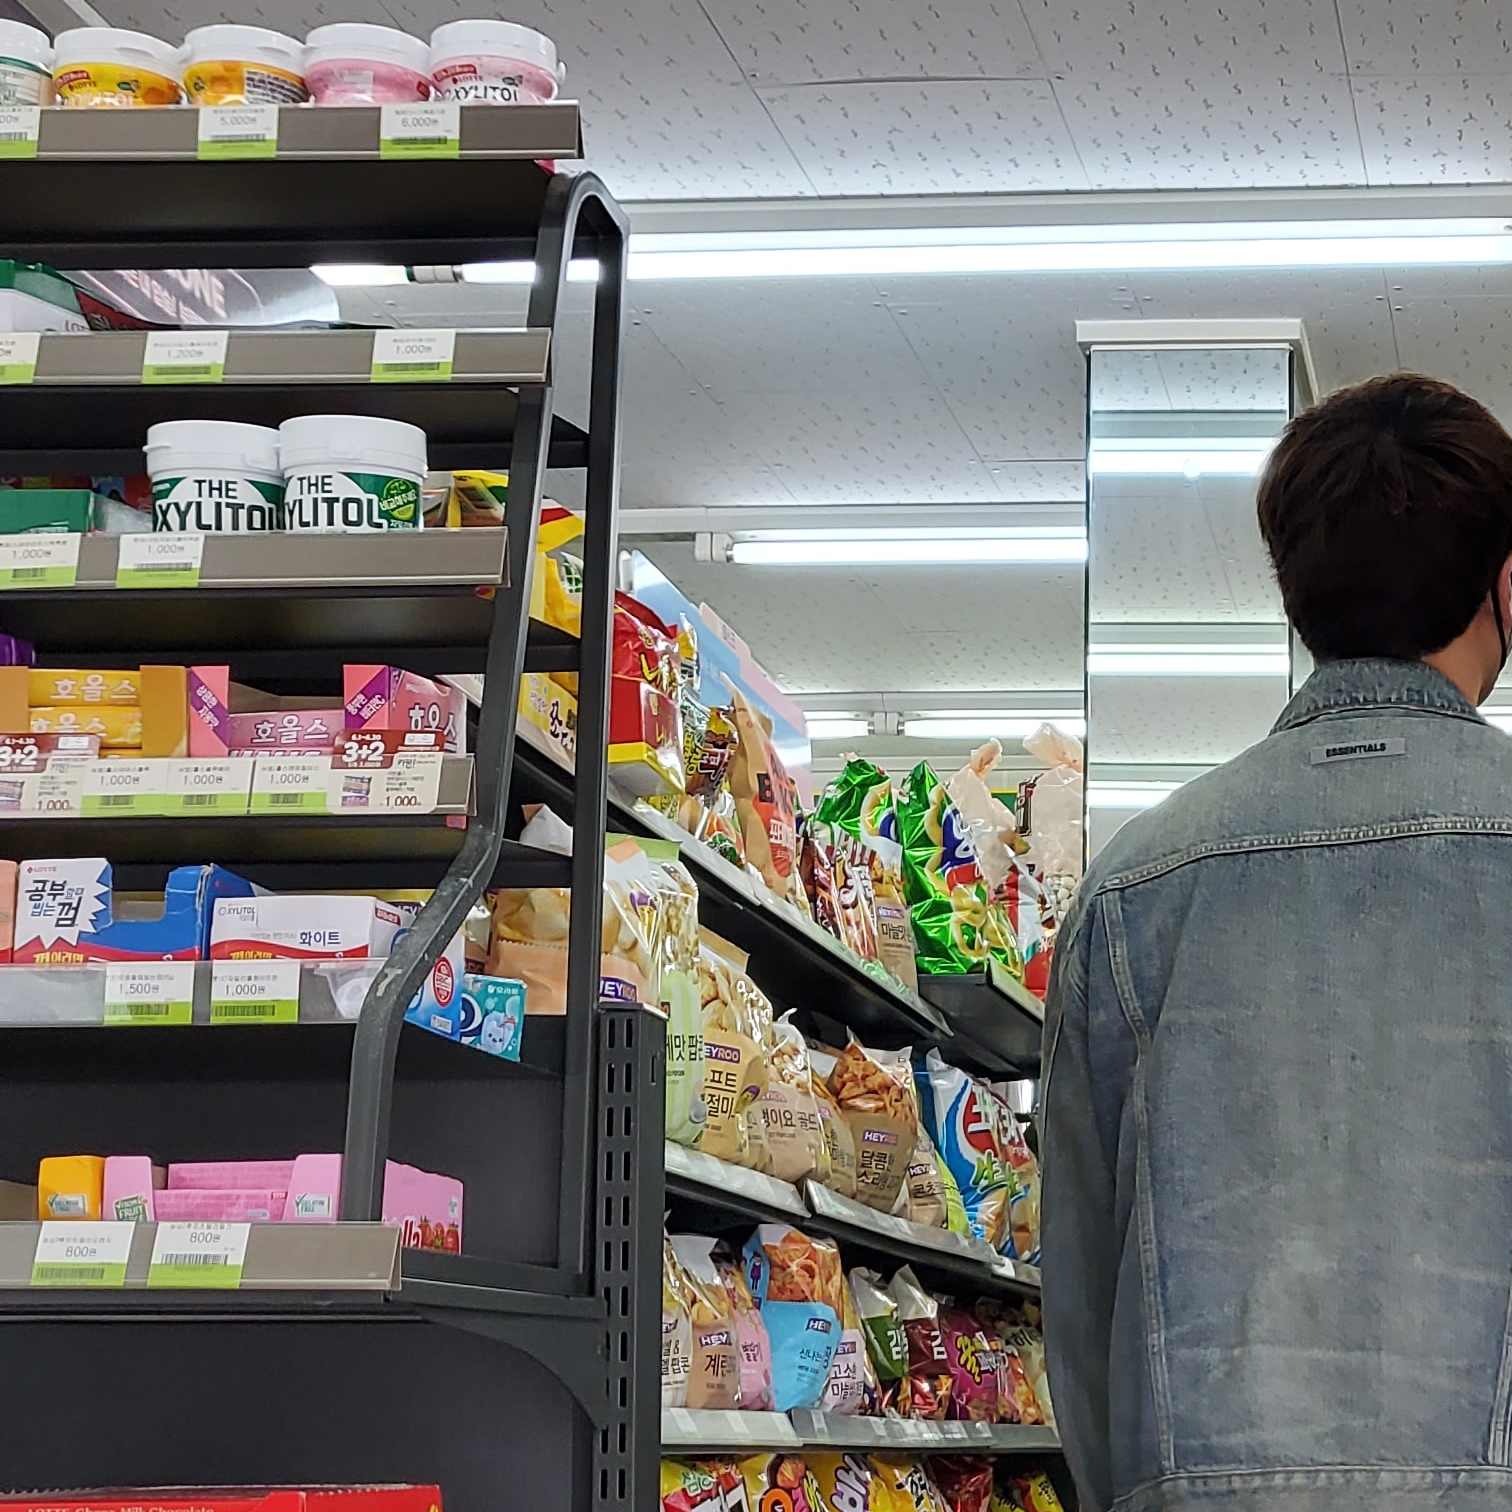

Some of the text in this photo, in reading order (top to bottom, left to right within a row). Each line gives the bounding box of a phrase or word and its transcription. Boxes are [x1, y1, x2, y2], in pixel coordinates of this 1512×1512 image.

[193, 479, 239, 499] THE
[297, 474, 334, 495] THE
[50, 674, 137, 702] 호올스
[251, 714, 329, 745] 호올스
[342, 741, 386, 763] 3+2
[1325, 742, 1387, 758] ESSENTIALS
[99, 774, 140, 786] 1,000원
[182, 774, 223, 786] 1,000원
[269, 773, 309, 785] 1,000원
[385, 795, 418, 809] 1,000
[55, 896, 83, 928] 껌
[298, 930, 342, 947] 화이트
[119, 983, 160, 995] 1,500원
[224, 984, 266, 996] 1,000원
[189, 1232, 220, 1244] 800원
[65, 1245, 97, 1258] 800원
